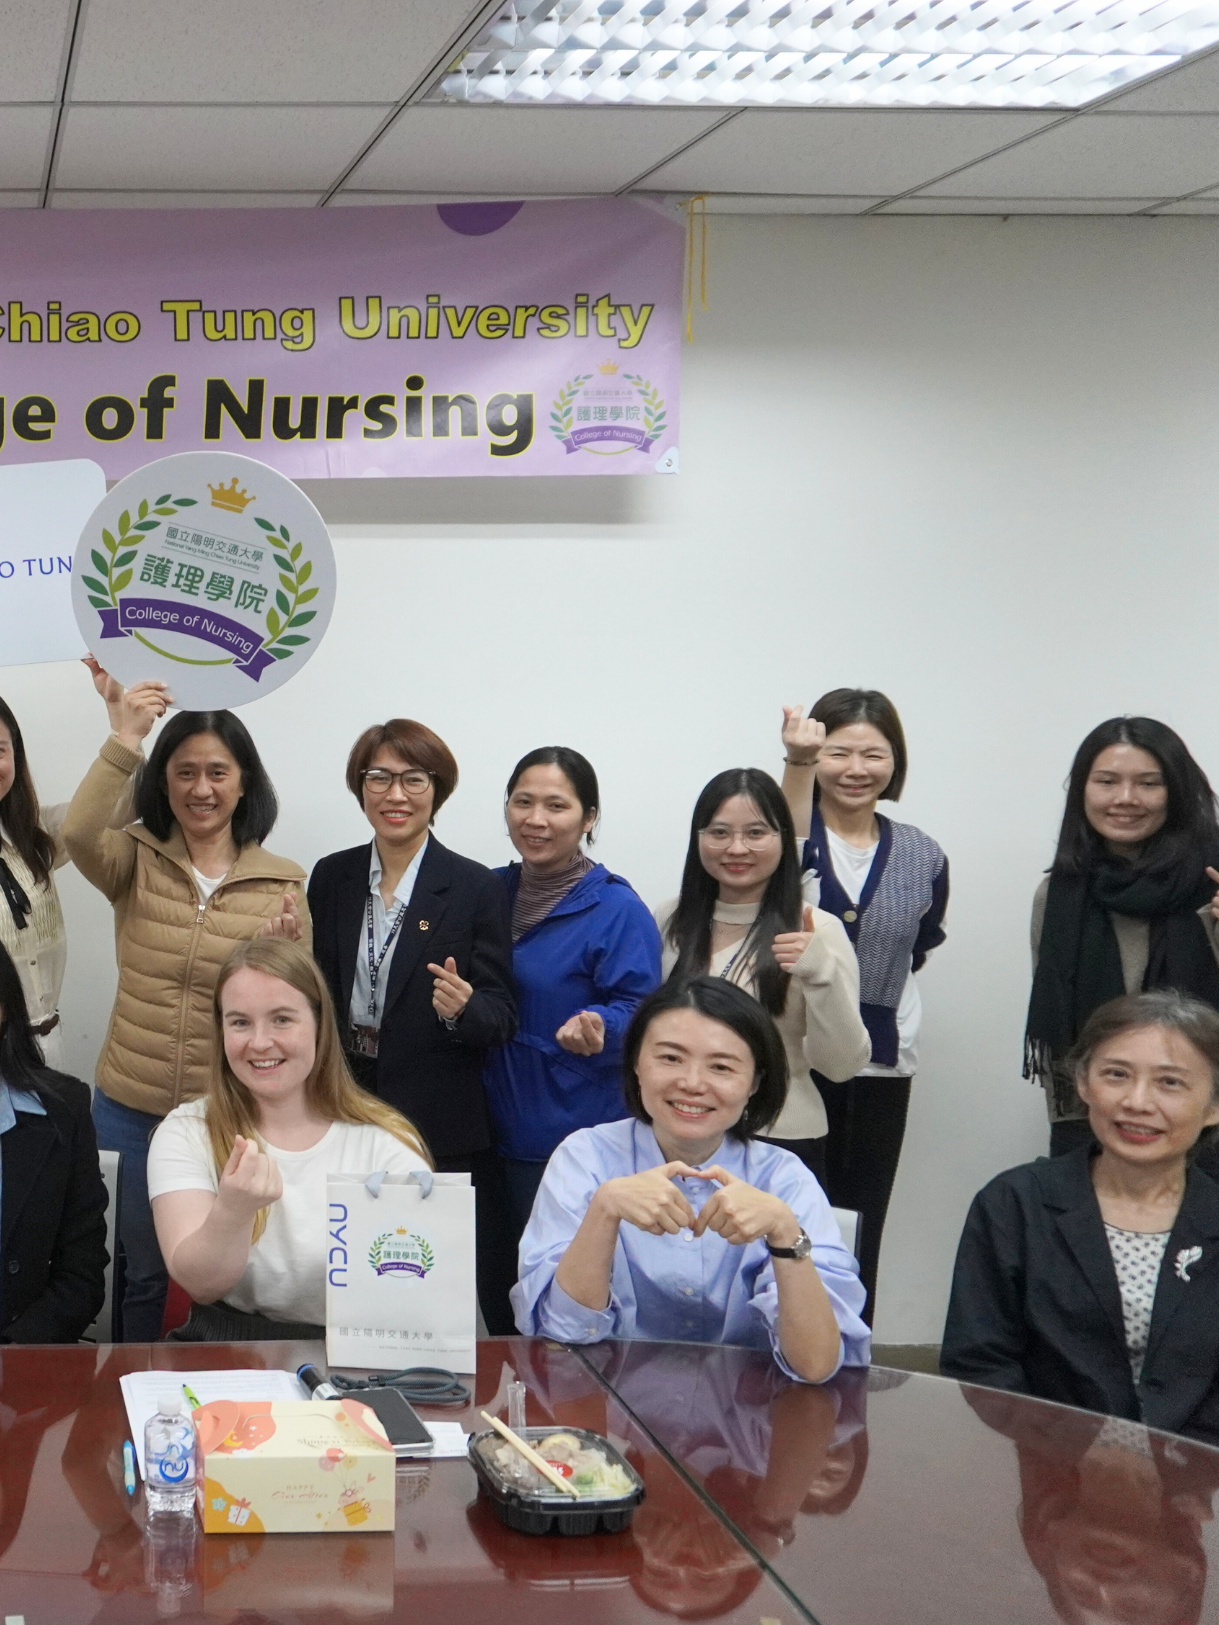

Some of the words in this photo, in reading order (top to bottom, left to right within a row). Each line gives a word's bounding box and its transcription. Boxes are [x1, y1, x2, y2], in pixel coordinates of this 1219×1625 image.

[160, 299, 316, 352] Tung
[338, 294, 656, 349] University
[84, 373, 179, 442] of
[201, 374, 537, 458] Nursing
[577, 406, 640, 421] 護理學院
[574, 430, 601, 441] College
[612, 430, 642, 442] Nursing
[166, 526, 264, 562] 國立陽明交通大學
[22, 554, 73, 578] TUN
[139, 553, 269, 614] 護理學院
[125, 606, 180, 626] College
[183, 612, 199, 626] of
[201, 618, 254, 655] Nursing
[329, 1203, 347, 1287] NYCU
[339, 1326, 434, 1341] 國立陽明交通大學
